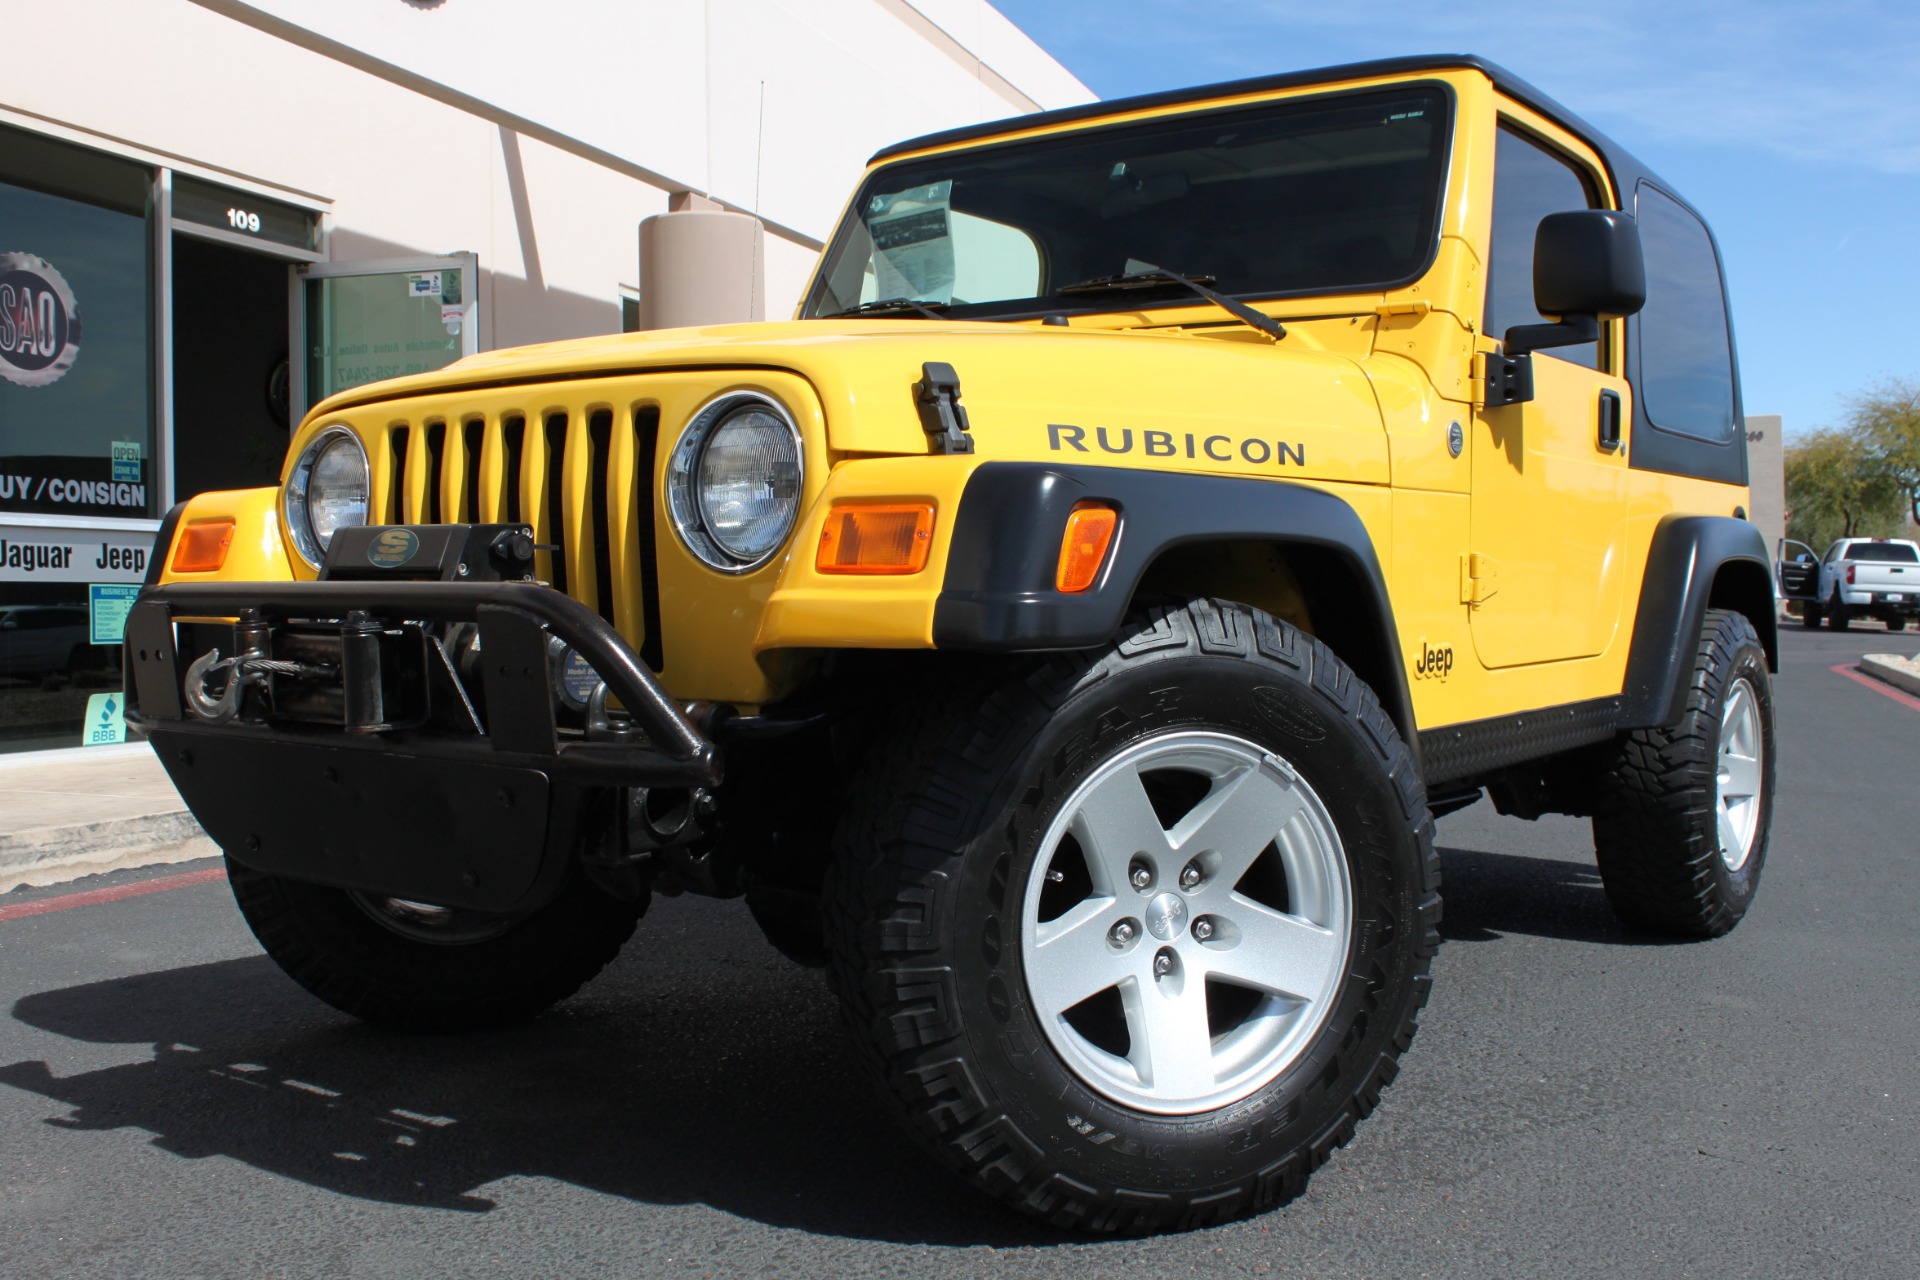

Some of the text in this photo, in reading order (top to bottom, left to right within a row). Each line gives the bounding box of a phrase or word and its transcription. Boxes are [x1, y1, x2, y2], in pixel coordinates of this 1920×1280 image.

[227, 208, 260, 232] 109
[0, 284, 56, 357] SAO
[113, 447, 139, 460] OPEN
[1047, 424, 1305, 466] RUBICON
[0, 539, 145, 573] Jaguar Jeep
[1416, 642, 1453, 677] Jeep
[93, 730, 116, 742] BBB
